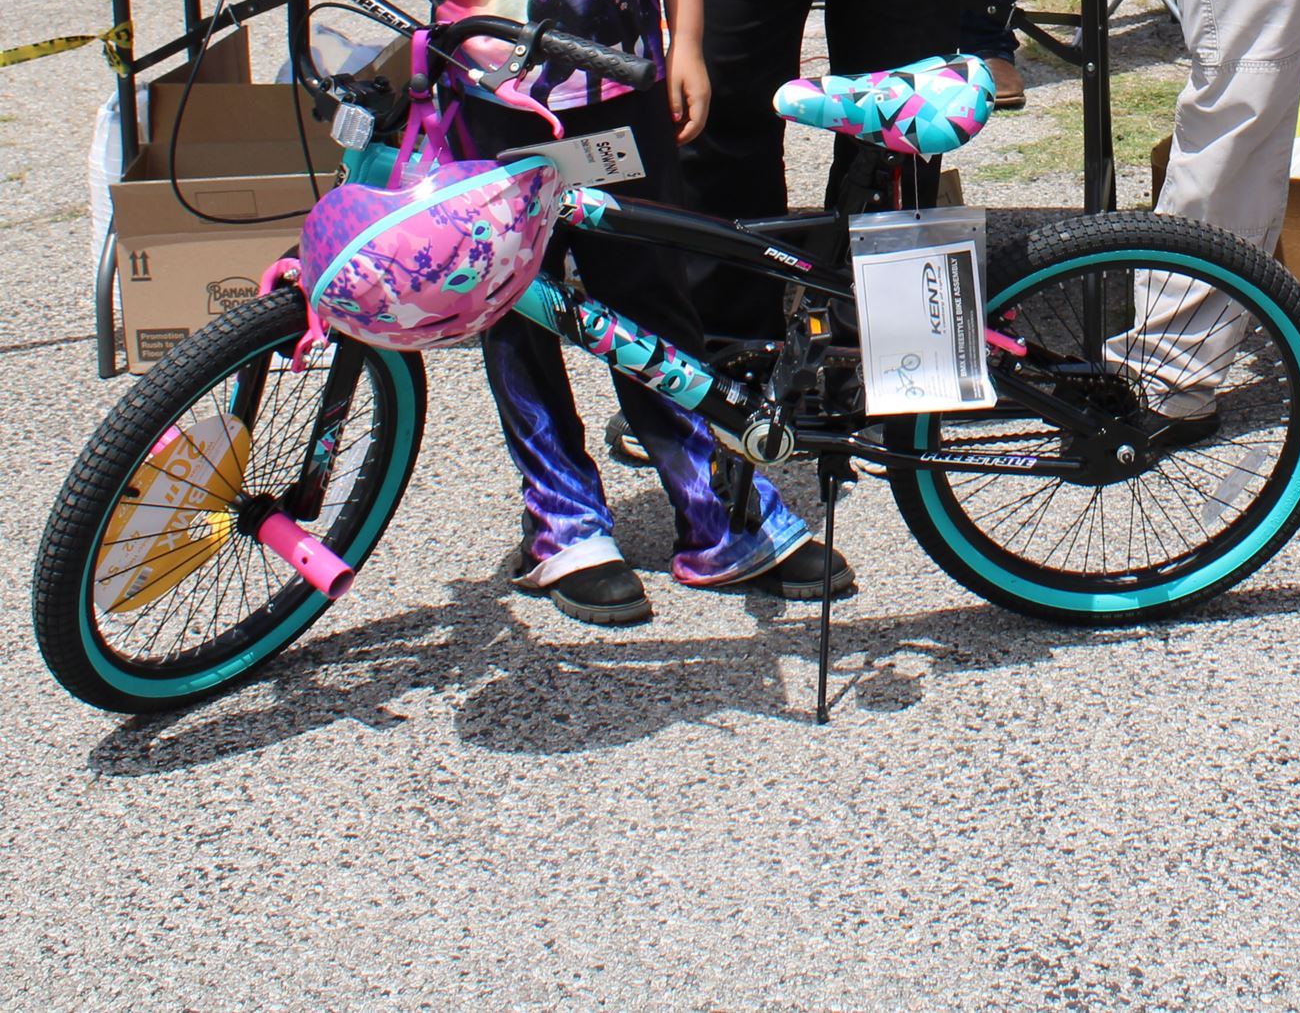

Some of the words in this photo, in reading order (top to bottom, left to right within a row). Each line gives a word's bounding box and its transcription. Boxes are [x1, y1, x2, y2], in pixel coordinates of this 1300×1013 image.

[596, 141, 619, 175] SCHWINN
[764, 247, 799, 266] PRO
[951, 258, 960, 296] ASSEMBLY
[926, 272, 942, 336] KENT
[141, 333, 185, 341] Promotion
[141, 341, 163, 349] Rush
[920, 452, 1037, 469] FREESTYLE
[157, 487, 208, 551] BMX
